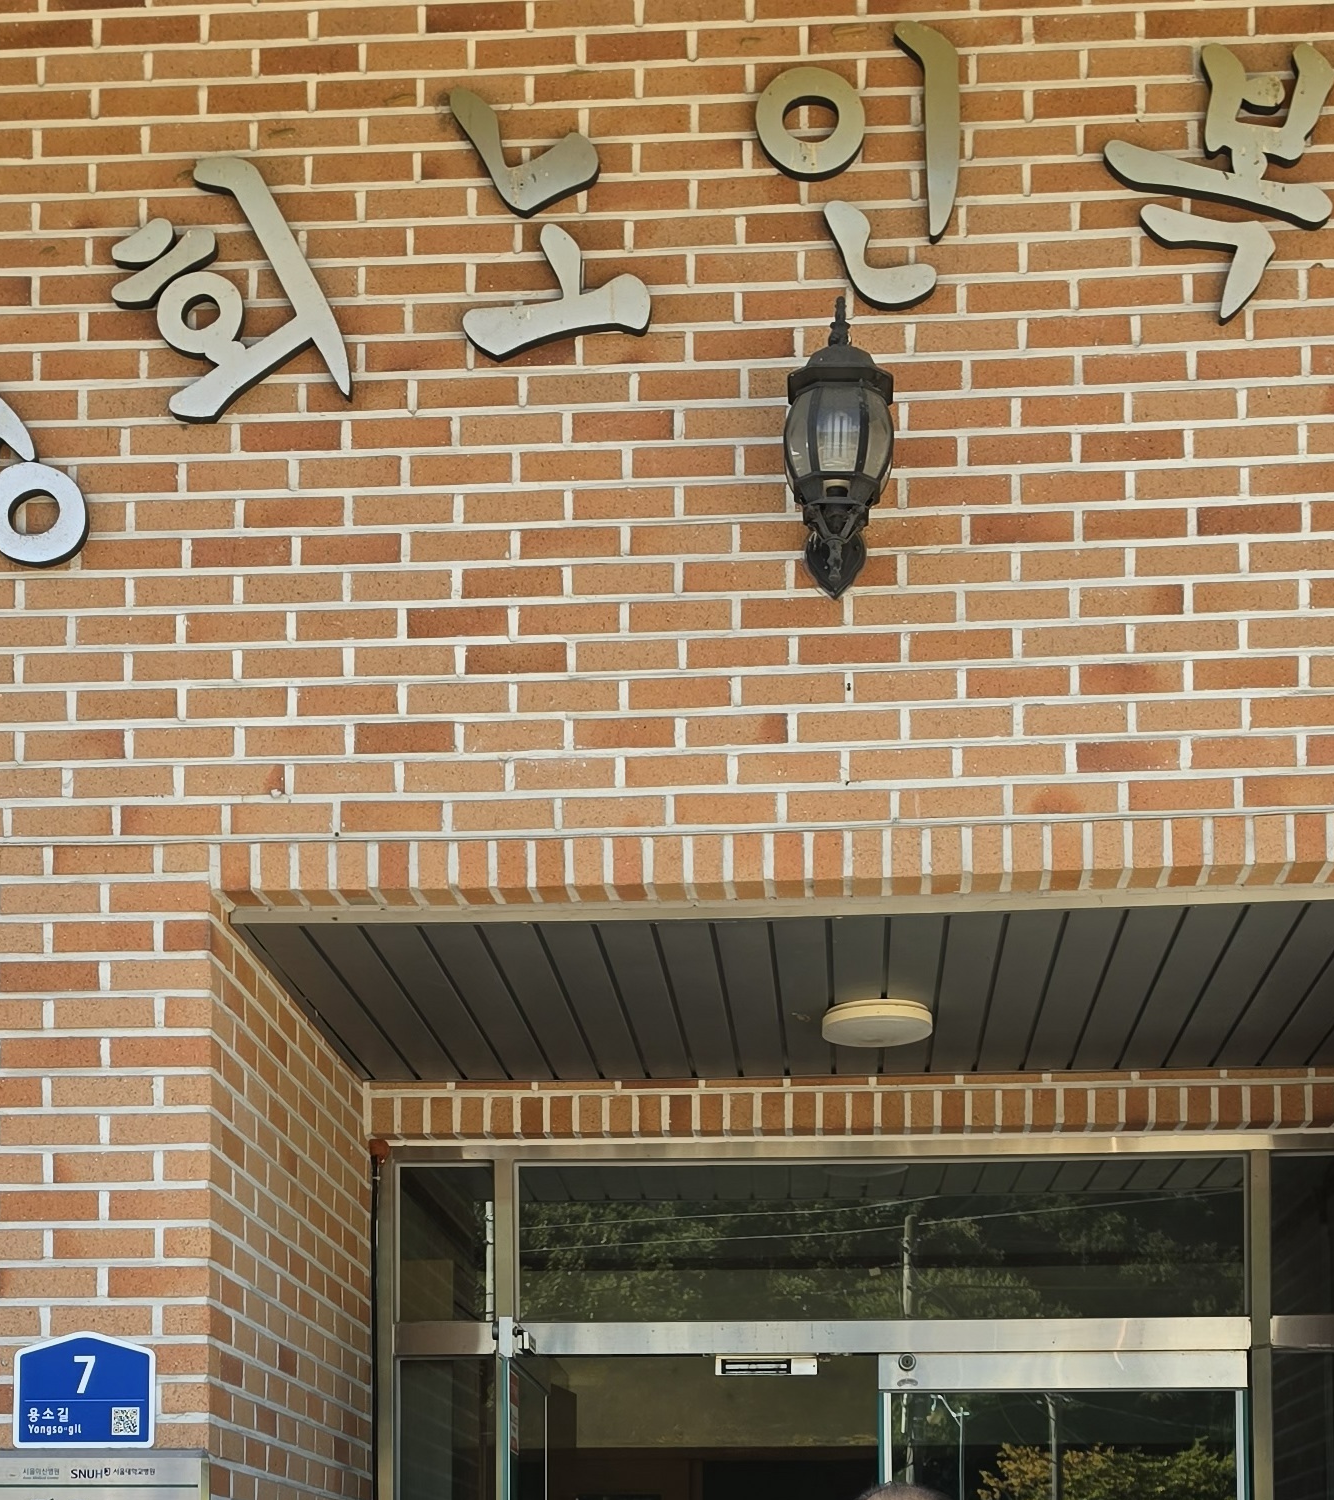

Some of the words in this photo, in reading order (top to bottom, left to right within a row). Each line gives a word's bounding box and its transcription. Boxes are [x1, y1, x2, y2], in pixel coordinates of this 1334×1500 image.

[73, 1355, 96, 1394] 7
[27, 1407, 69, 1423] 용소길
[28, 1424, 82, 1435] Yongso-gil
[70, 1468, 103, 1479] SNUH
